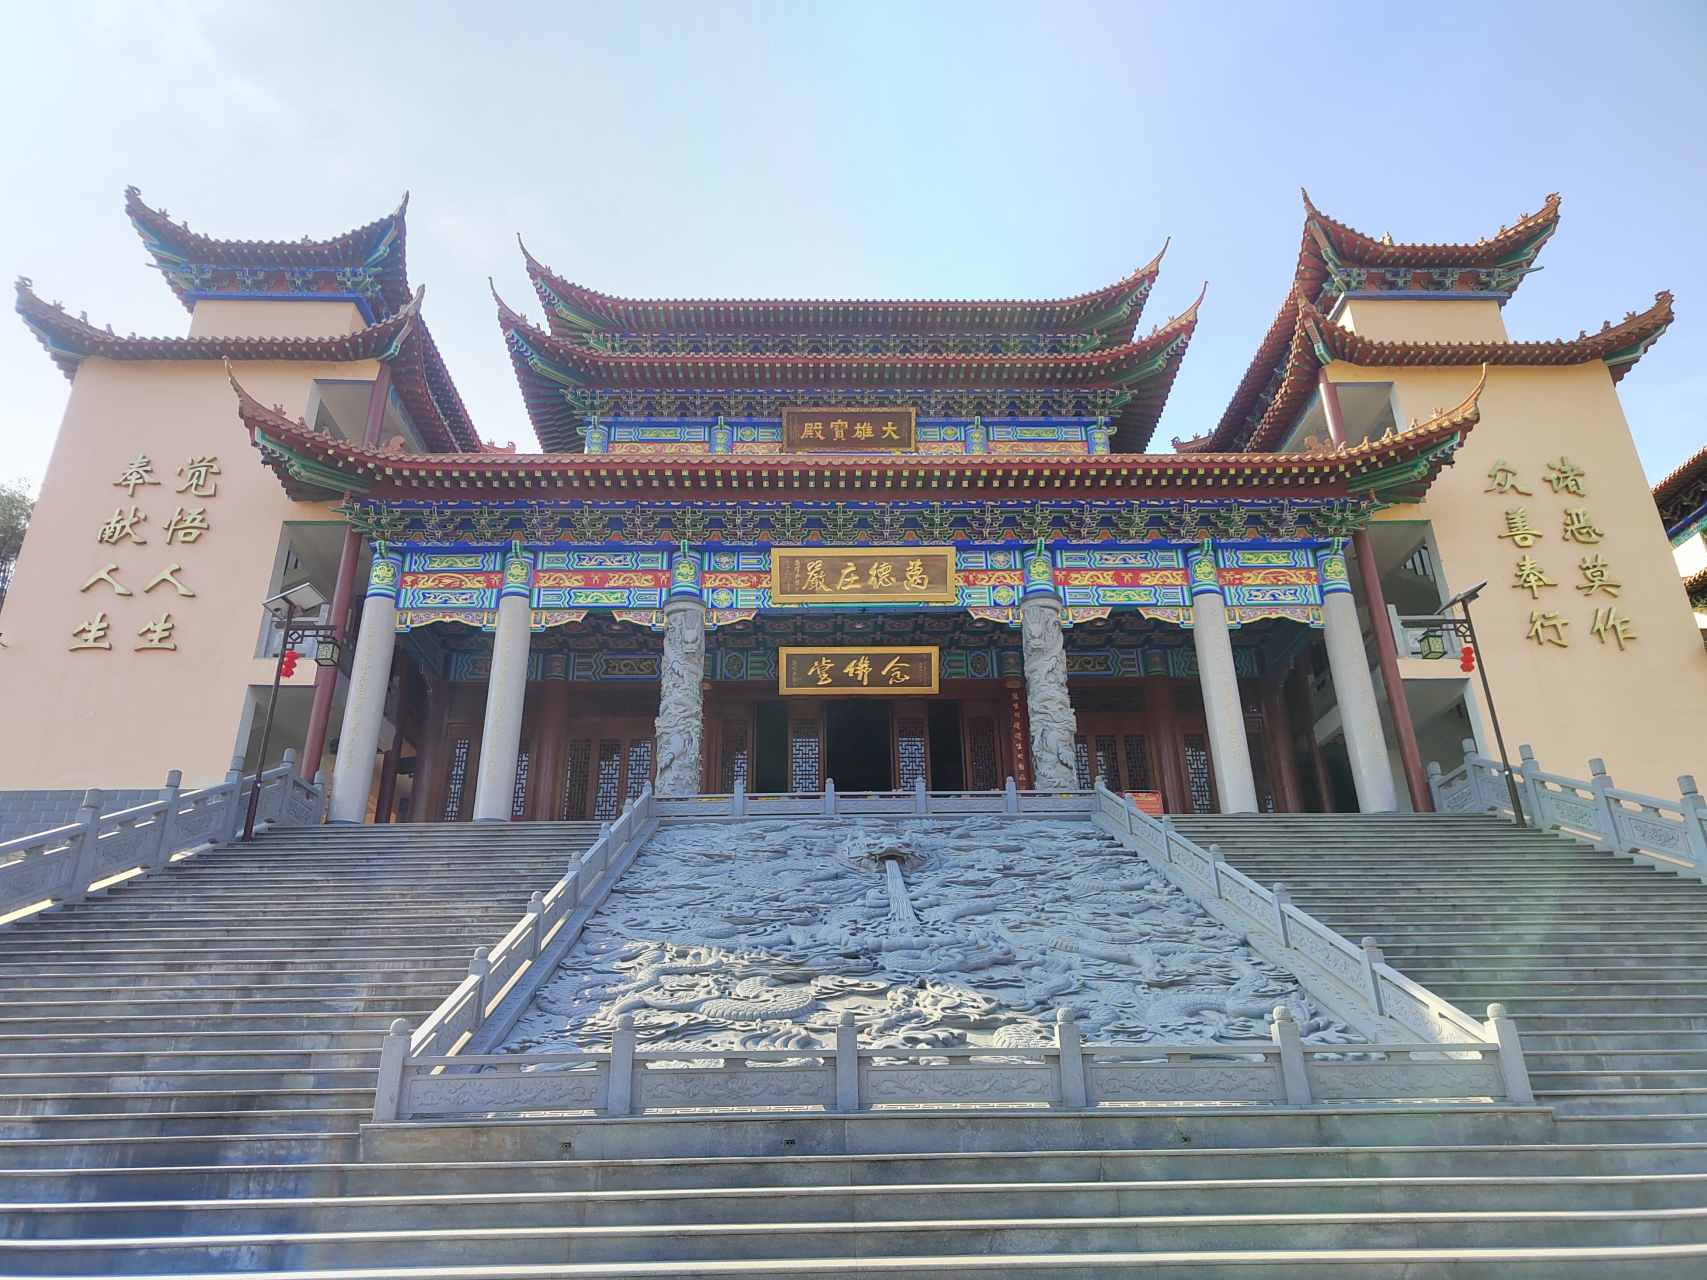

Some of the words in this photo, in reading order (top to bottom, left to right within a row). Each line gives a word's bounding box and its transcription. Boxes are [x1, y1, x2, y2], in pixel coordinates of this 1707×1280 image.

[800, 418, 901, 441] 大雄寶殿
[68, 453, 162, 652] 奉献人生
[134, 453, 222, 652] 觉悟人生
[801, 558, 929, 592] 萬德庄嚴
[1484, 458, 1570, 649] 众善奉行
[1542, 456, 1638, 651] 诸恶莫作
[807, 656, 911, 686] 念佛堂
